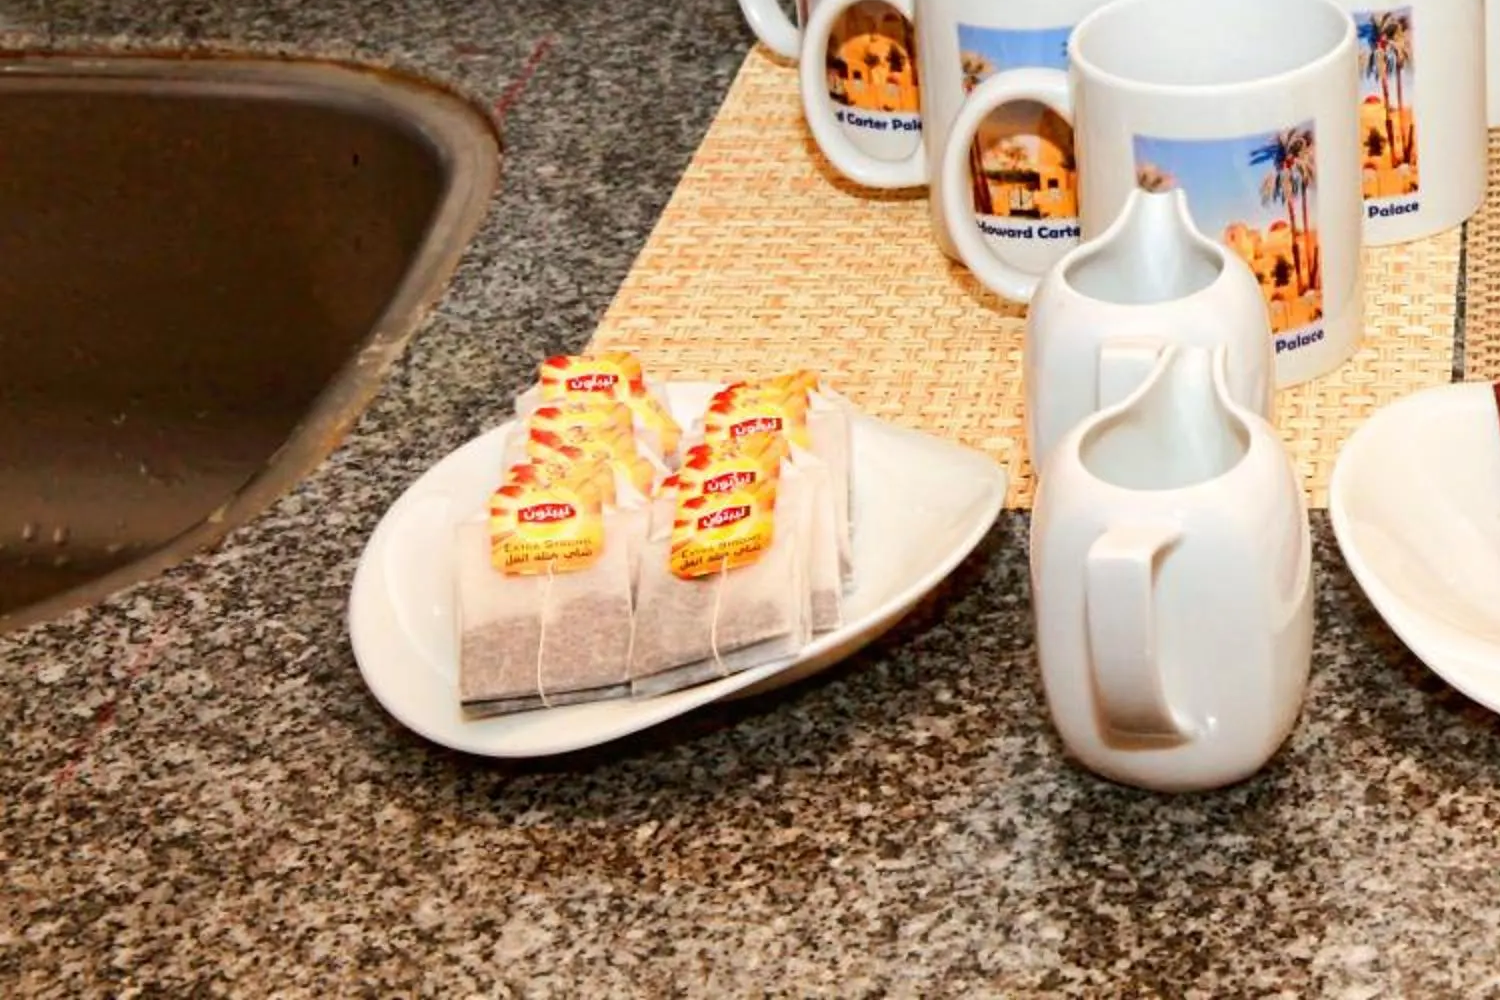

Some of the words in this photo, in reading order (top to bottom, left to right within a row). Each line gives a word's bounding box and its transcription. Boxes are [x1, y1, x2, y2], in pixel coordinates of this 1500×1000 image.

[847, 112, 888, 130] Carter
[1368, 202, 1419, 219] Palace
[1037, 224, 1081, 240] Carte
[1275, 328, 1325, 355] Palace
